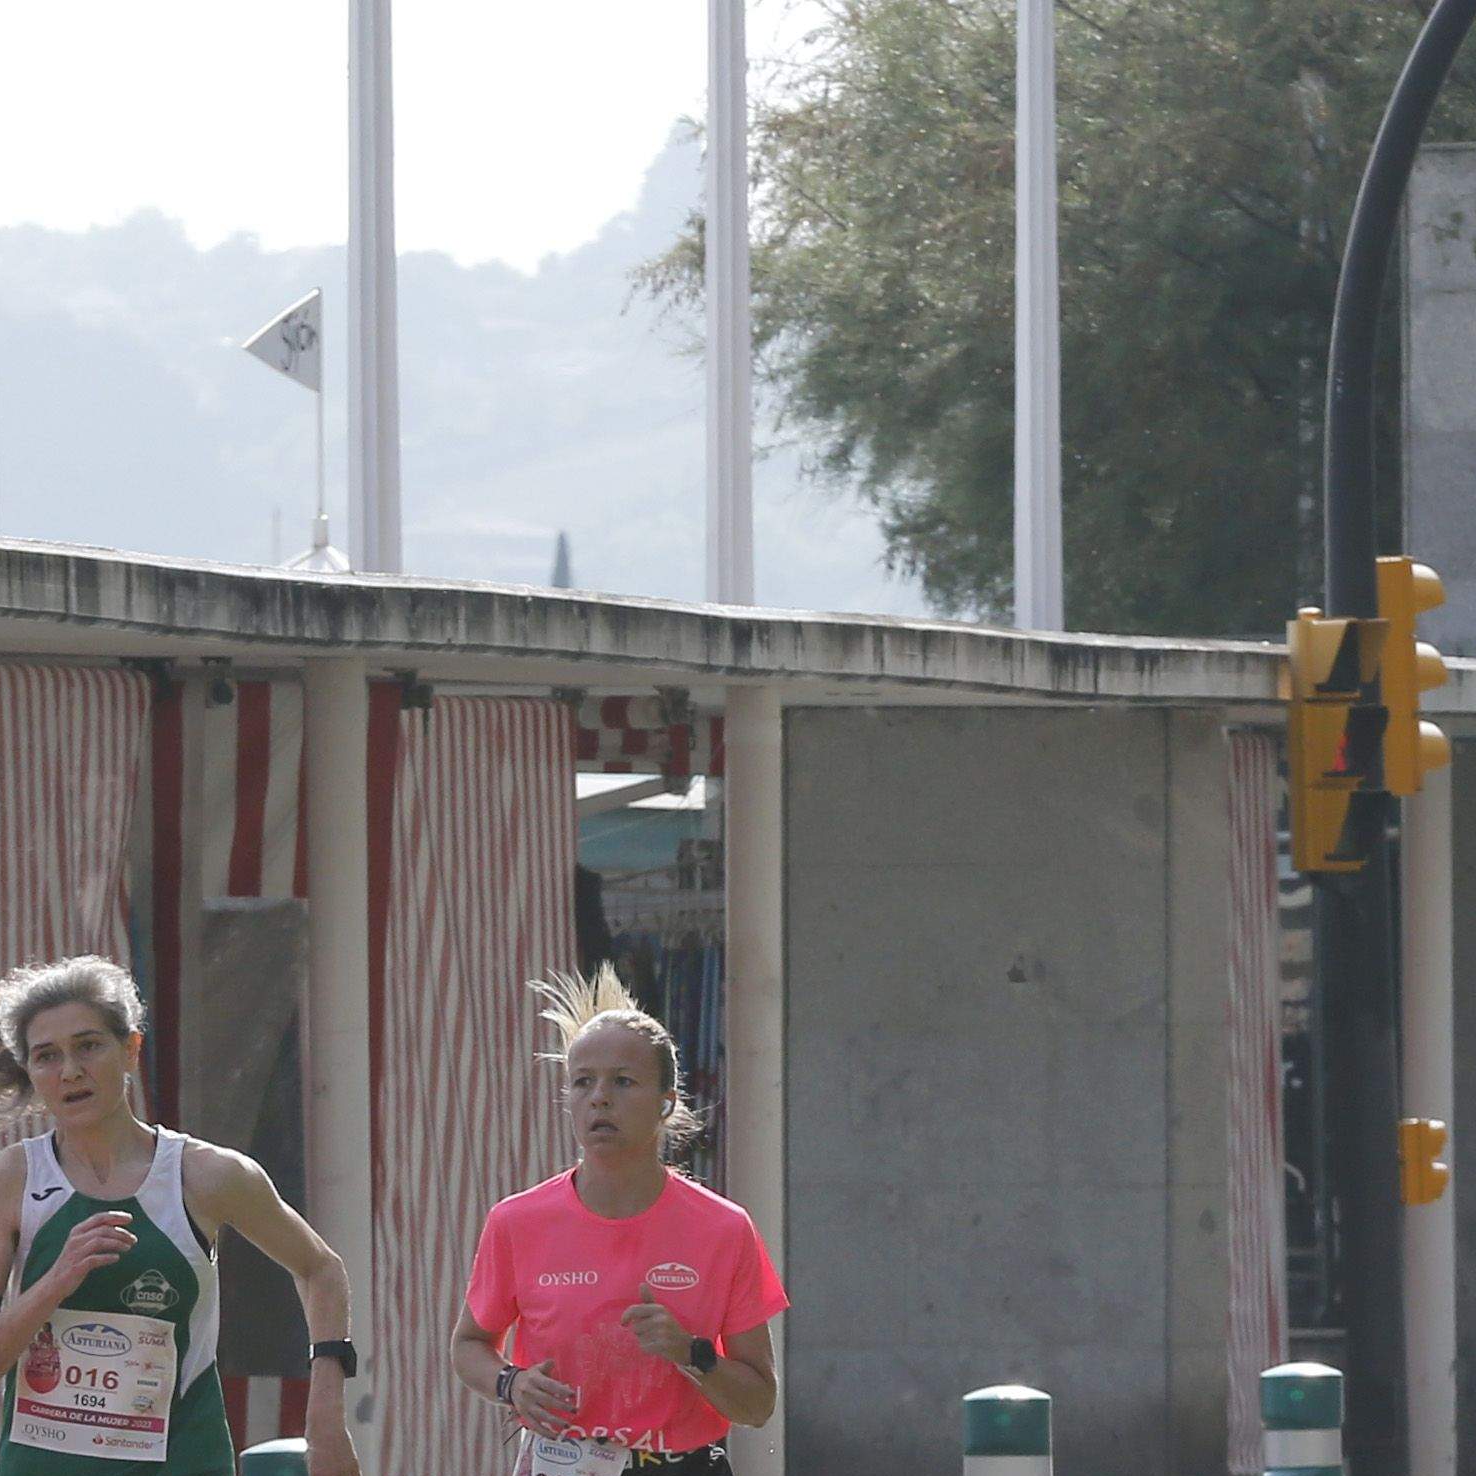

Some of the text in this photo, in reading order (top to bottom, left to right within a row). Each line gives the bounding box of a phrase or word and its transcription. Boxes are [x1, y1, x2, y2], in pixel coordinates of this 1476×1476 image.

[538, 1271, 598, 1287] OYSHO
[651, 1272, 695, 1284] ASTURIANA
[67, 1334, 126, 1351] ASTURIANA
[137, 1336, 166, 1347] SUMA
[65, 1365, 119, 1390] 016
[73, 1393, 106, 1409] 1694
[30, 1404, 67, 1419] CARRERA
[69, 1412, 82, 1421] DE
[84, 1413, 97, 1422] LA
[98, 1415, 130, 1426] MUJER
[24, 1423, 66, 1442] OYSHO
[105, 1435, 154, 1450] Santander
[538, 1443, 577, 1460] ASTURIANA
